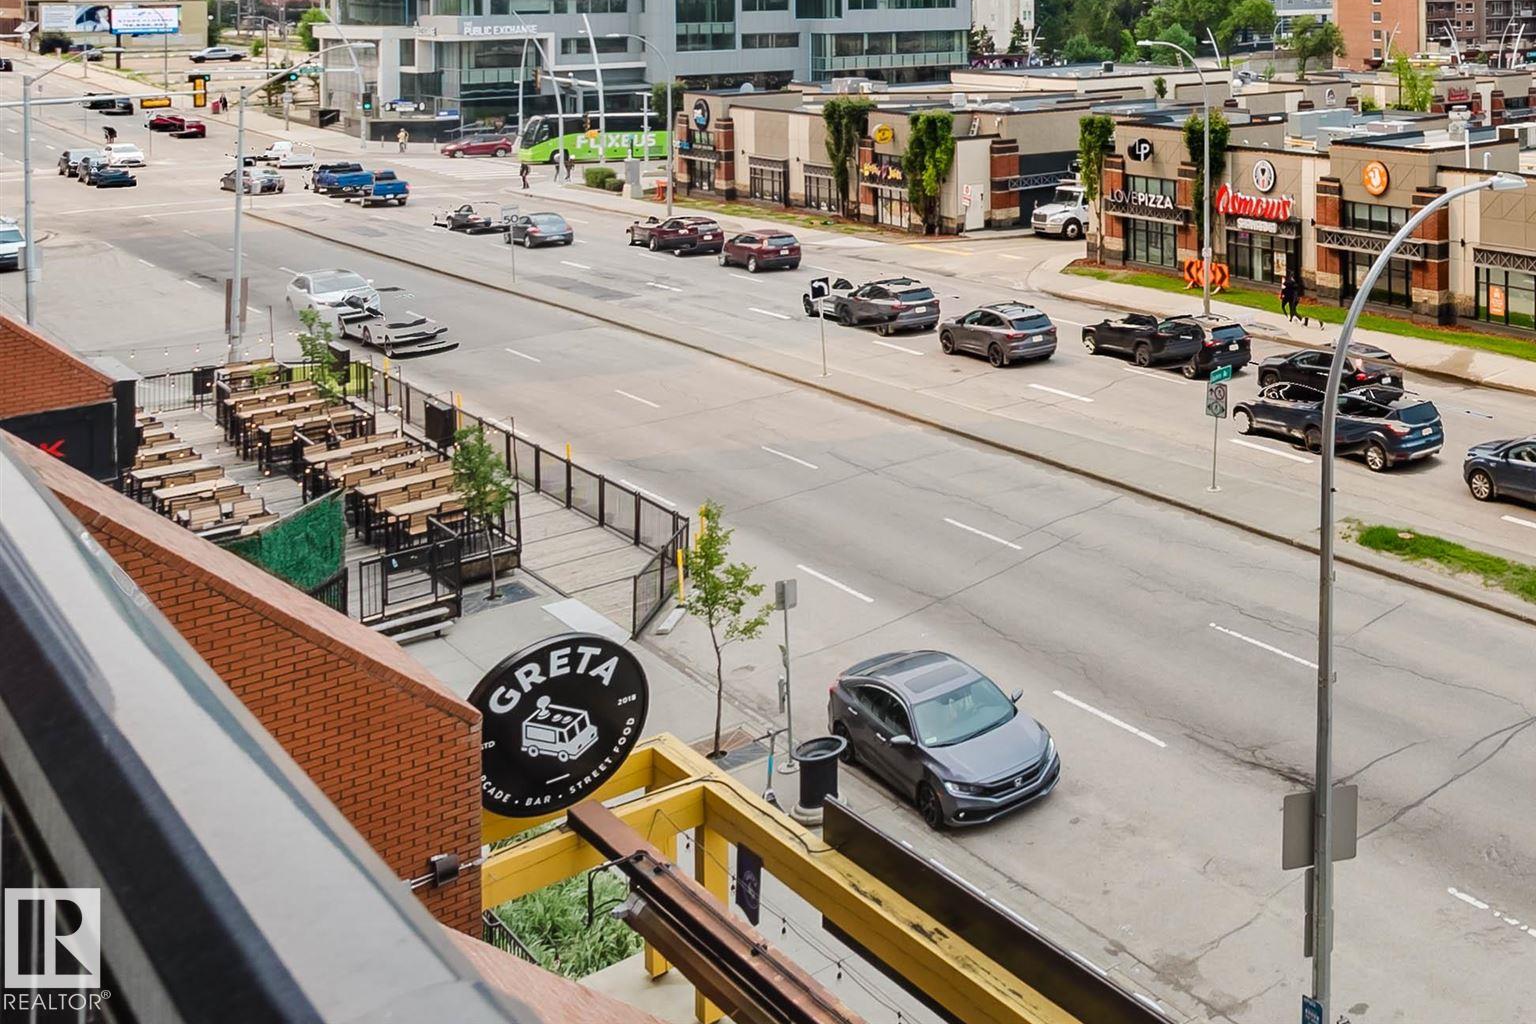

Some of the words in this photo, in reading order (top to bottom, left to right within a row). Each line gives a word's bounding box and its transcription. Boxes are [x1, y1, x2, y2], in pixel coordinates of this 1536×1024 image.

[464, 26, 492, 36] PUBLIC
[576, 133, 656, 149] FLXBUS
[503, 214, 518, 224] 50
[488, 645, 619, 714] GRETA
[525, 795, 552, 807] BAR
[569, 758, 613, 794] STREET
[613, 717, 636, 754] FOOD
